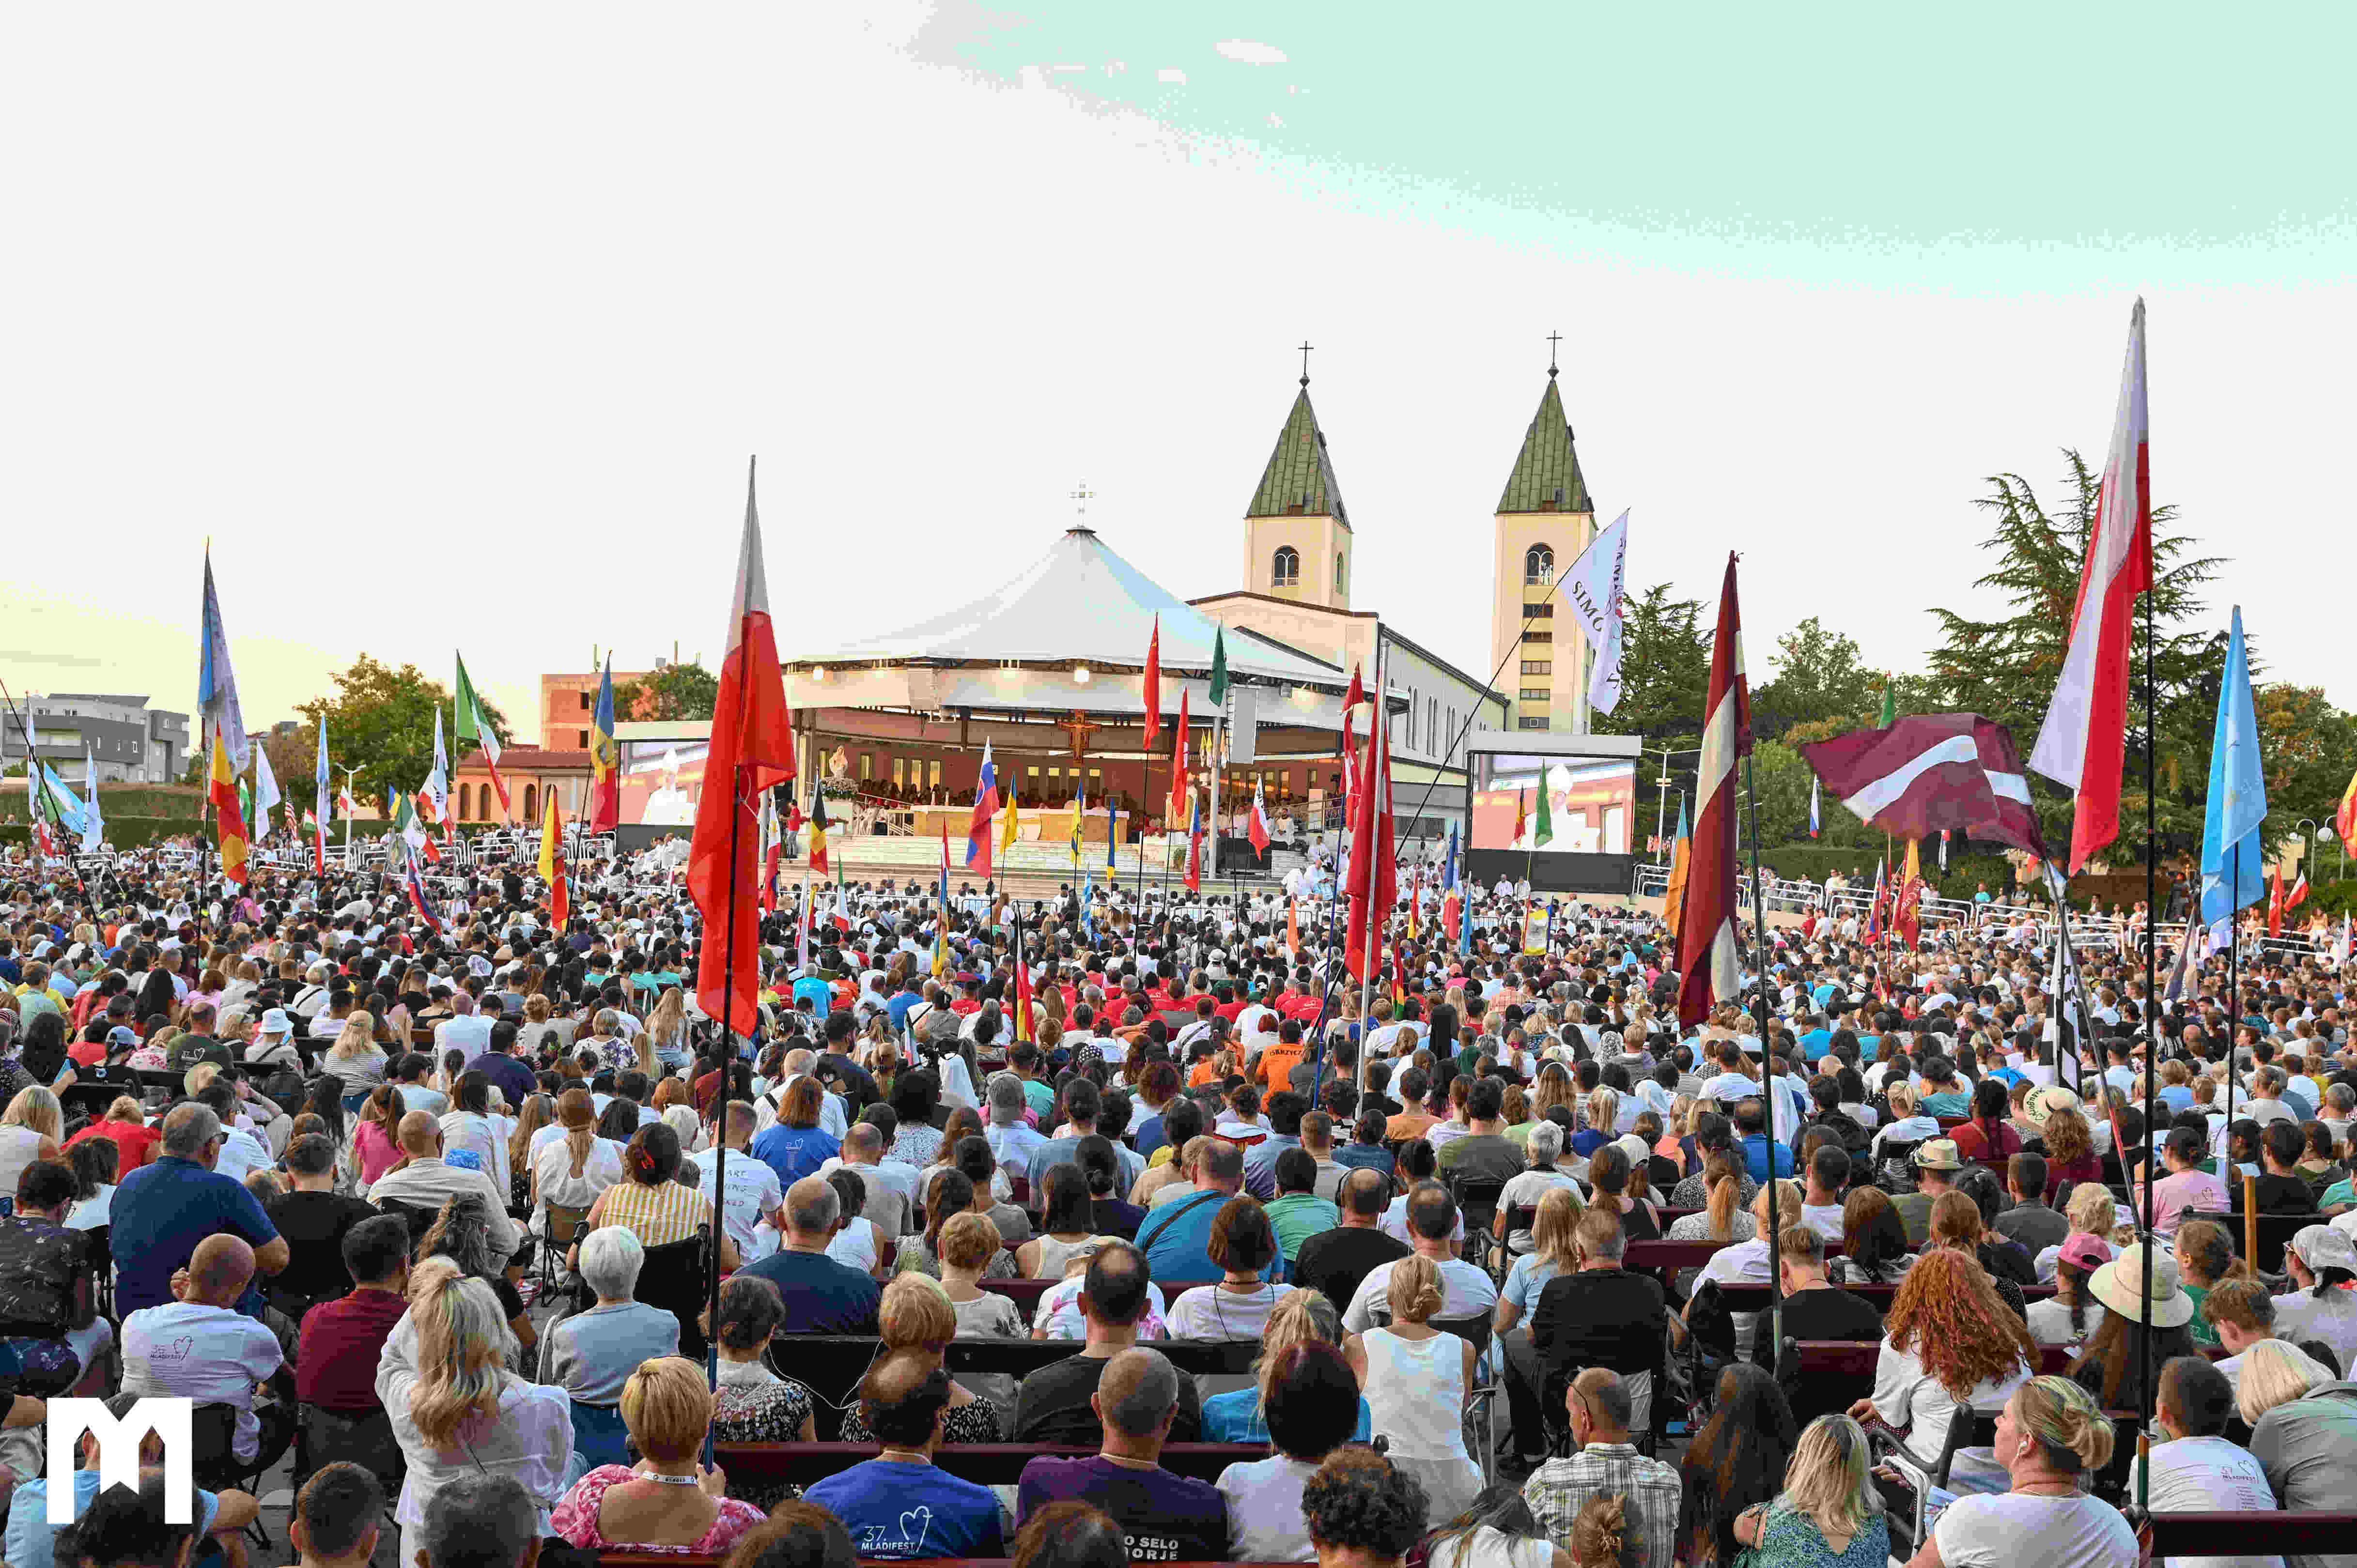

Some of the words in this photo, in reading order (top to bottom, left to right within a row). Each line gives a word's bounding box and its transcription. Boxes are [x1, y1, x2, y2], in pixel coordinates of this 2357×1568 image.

[864, 1526, 886, 1542] 37.
[861, 1542, 915, 1550] MLADIFEST
[1139, 1537, 1178, 1550] SELO
